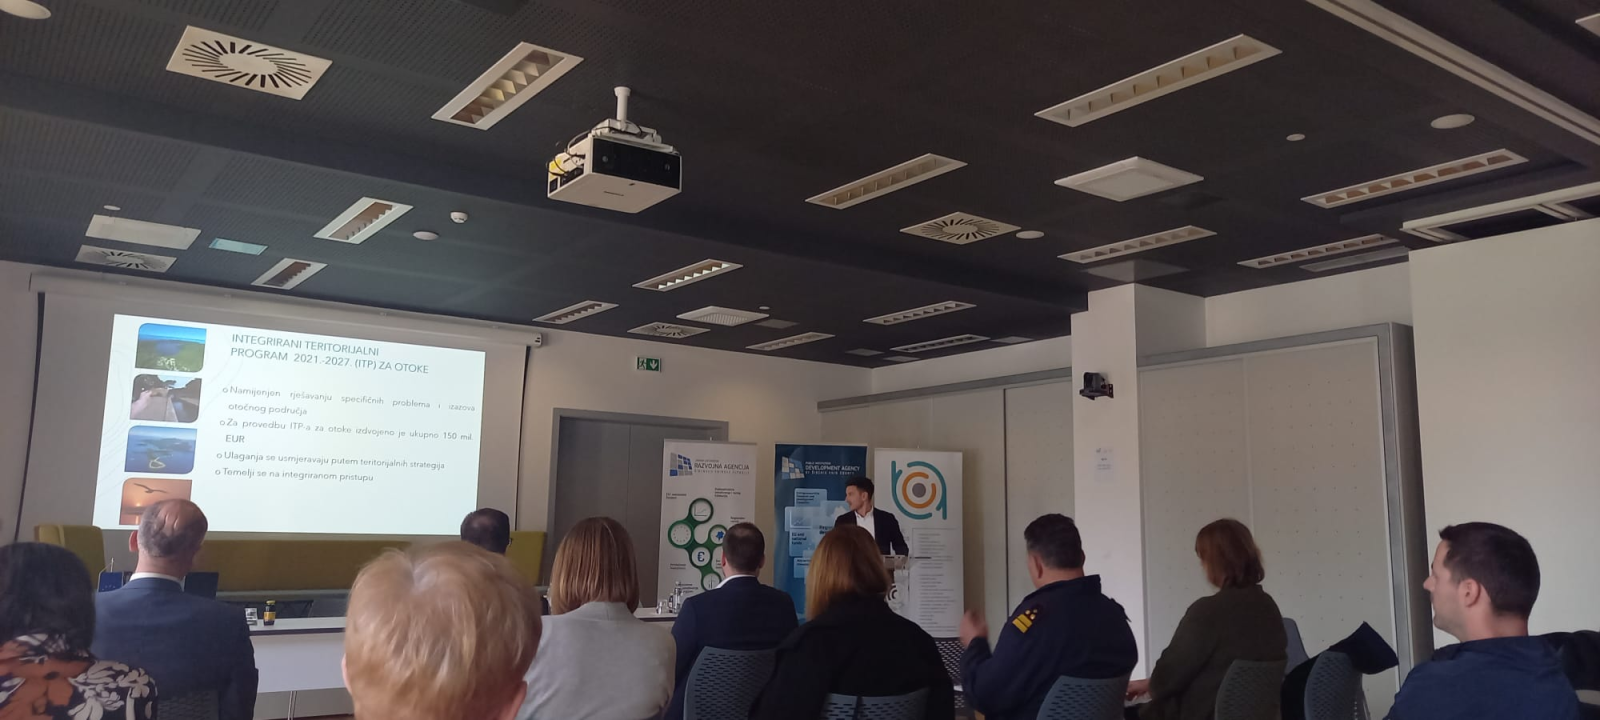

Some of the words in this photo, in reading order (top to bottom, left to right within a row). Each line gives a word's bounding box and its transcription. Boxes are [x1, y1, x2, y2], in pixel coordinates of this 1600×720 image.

[231, 333, 302, 349] INTEGRIRANI
[304, 340, 380, 356] TERITORIJALNI
[230, 347, 288, 361] PROGRAM
[293, 353, 353, 367] 2021.-2027.
[354, 359, 377, 370] (ITP)
[378, 361, 393, 371] ZA
[394, 362, 429, 374] OTOKE
[229, 385, 281, 398] Namijenjen
[290, 390, 332, 402] rješavanju
[341, 394, 384, 405] specifičnih
[392, 399, 431, 409] problema
[448, 403, 476, 412] izazova
[228, 403, 267, 414] otočnog
[268, 406, 308, 417] područja
[225, 434, 246, 444] EUR
[226, 418, 238, 427] Za
[242, 421, 286, 430] provedbu
[289, 422, 311, 431] ITP-a
[327, 426, 352, 434] otoke
[355, 427, 396, 437] izdvojeno
[409, 430, 440, 439] ukupno
[443, 432, 458, 440] 150
[460, 433, 474, 441] mil.
[224, 451, 264, 463] Ulaganja
[278, 455, 329, 466] usmjeravaju
[330, 457, 359, 466] putem
[360, 459, 408, 469] teritorijalnih
[409, 462, 445, 471] strategija
[694, 462, 723, 470] RAZVOJNA
[223, 467, 255, 479] Temelji
[282, 470, 338, 481] integriranom
[339, 473, 374, 482] pristupu
